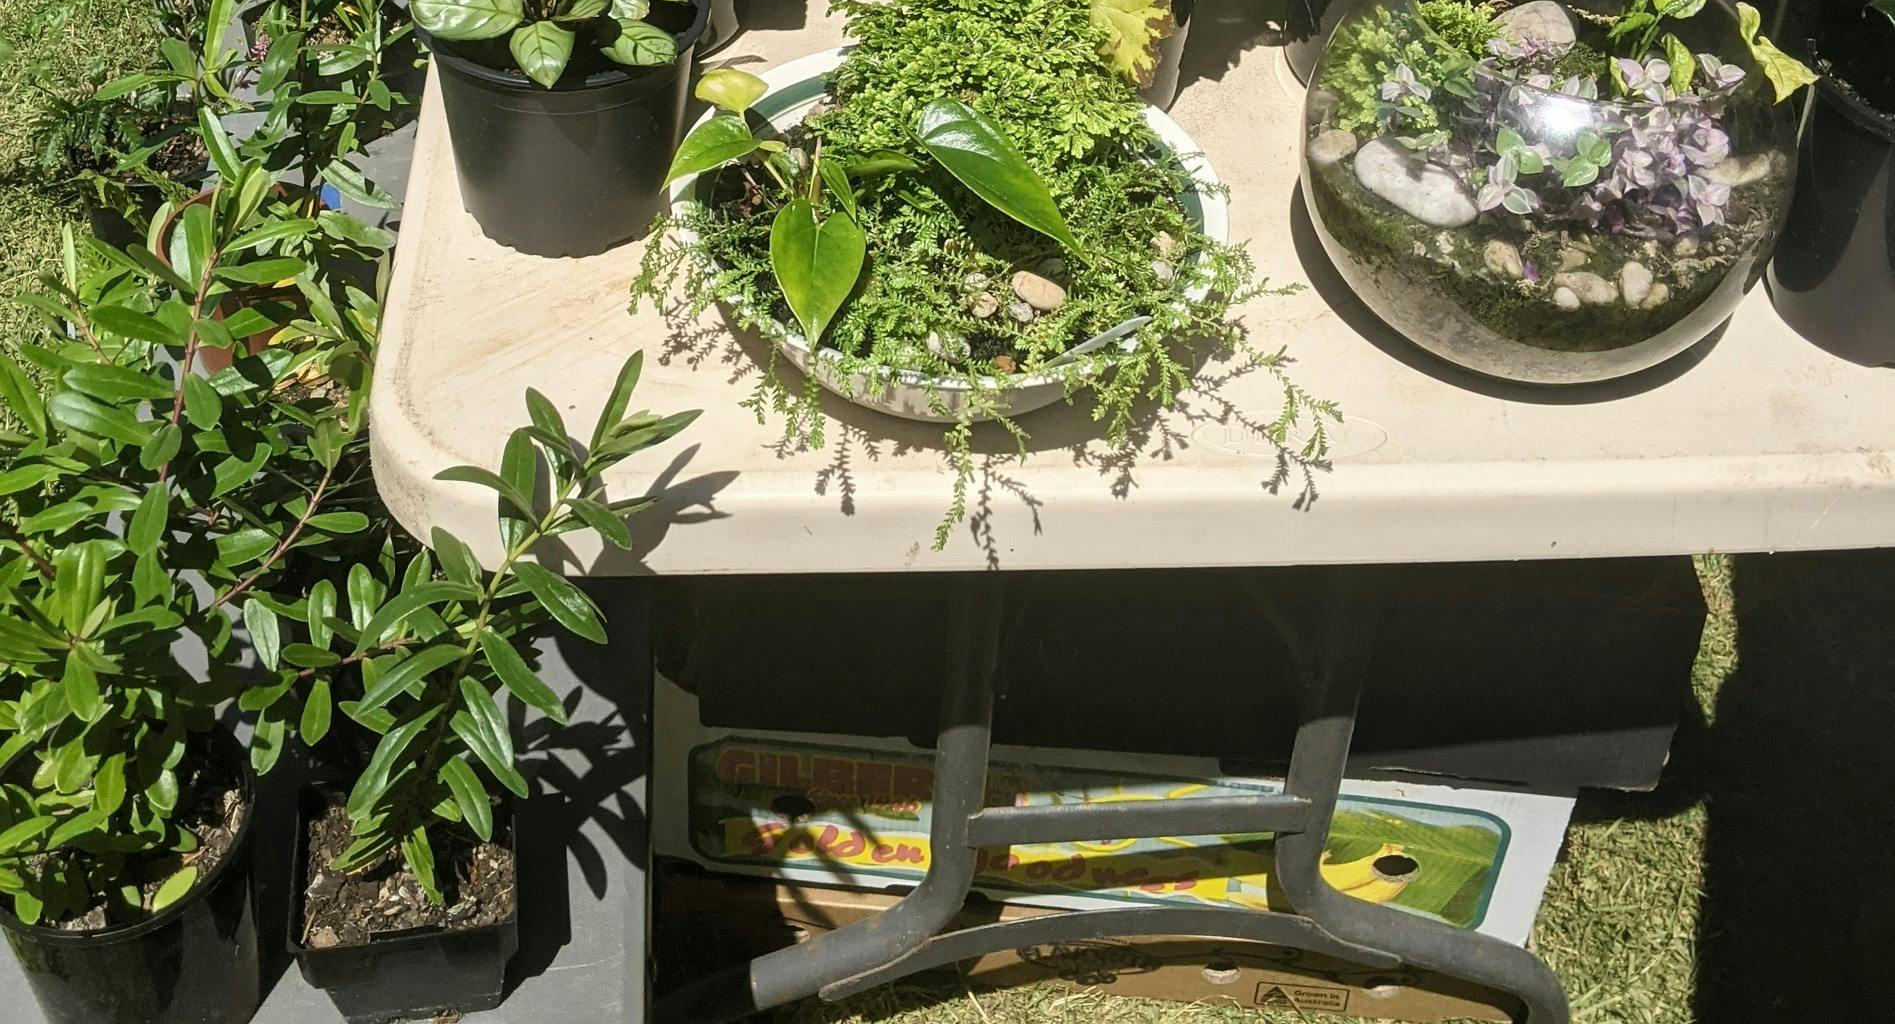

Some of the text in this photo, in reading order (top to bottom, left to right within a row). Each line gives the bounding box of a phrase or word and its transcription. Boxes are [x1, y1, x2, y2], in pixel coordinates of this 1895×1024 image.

[717, 750, 935, 800] GILBER
[742, 822, 1200, 892] Golden oodness
[1294, 990, 1327, 998] Grown
[1294, 997, 1340, 1007] Australia
